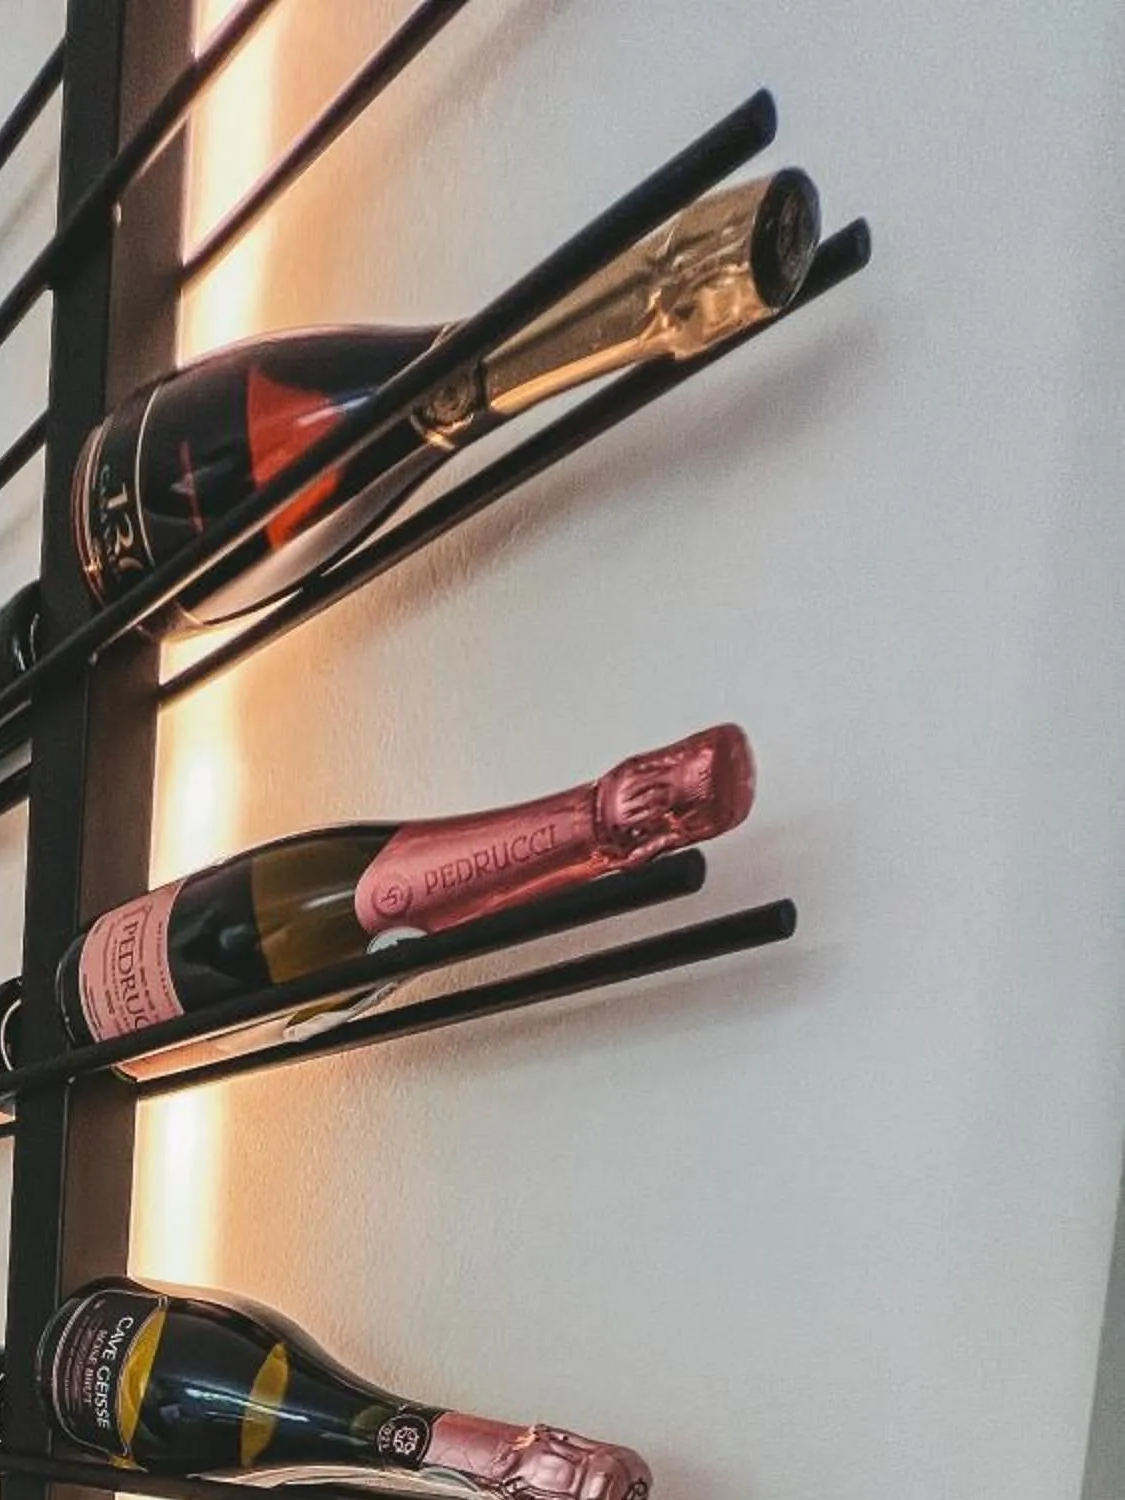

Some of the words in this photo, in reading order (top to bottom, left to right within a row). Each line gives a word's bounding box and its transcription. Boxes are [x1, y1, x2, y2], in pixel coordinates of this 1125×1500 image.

[425, 824, 559, 896] PEDRUCCI
[102, 1316, 134, 1360] CAVE
[95, 1365, 112, 1429] GEISSE
